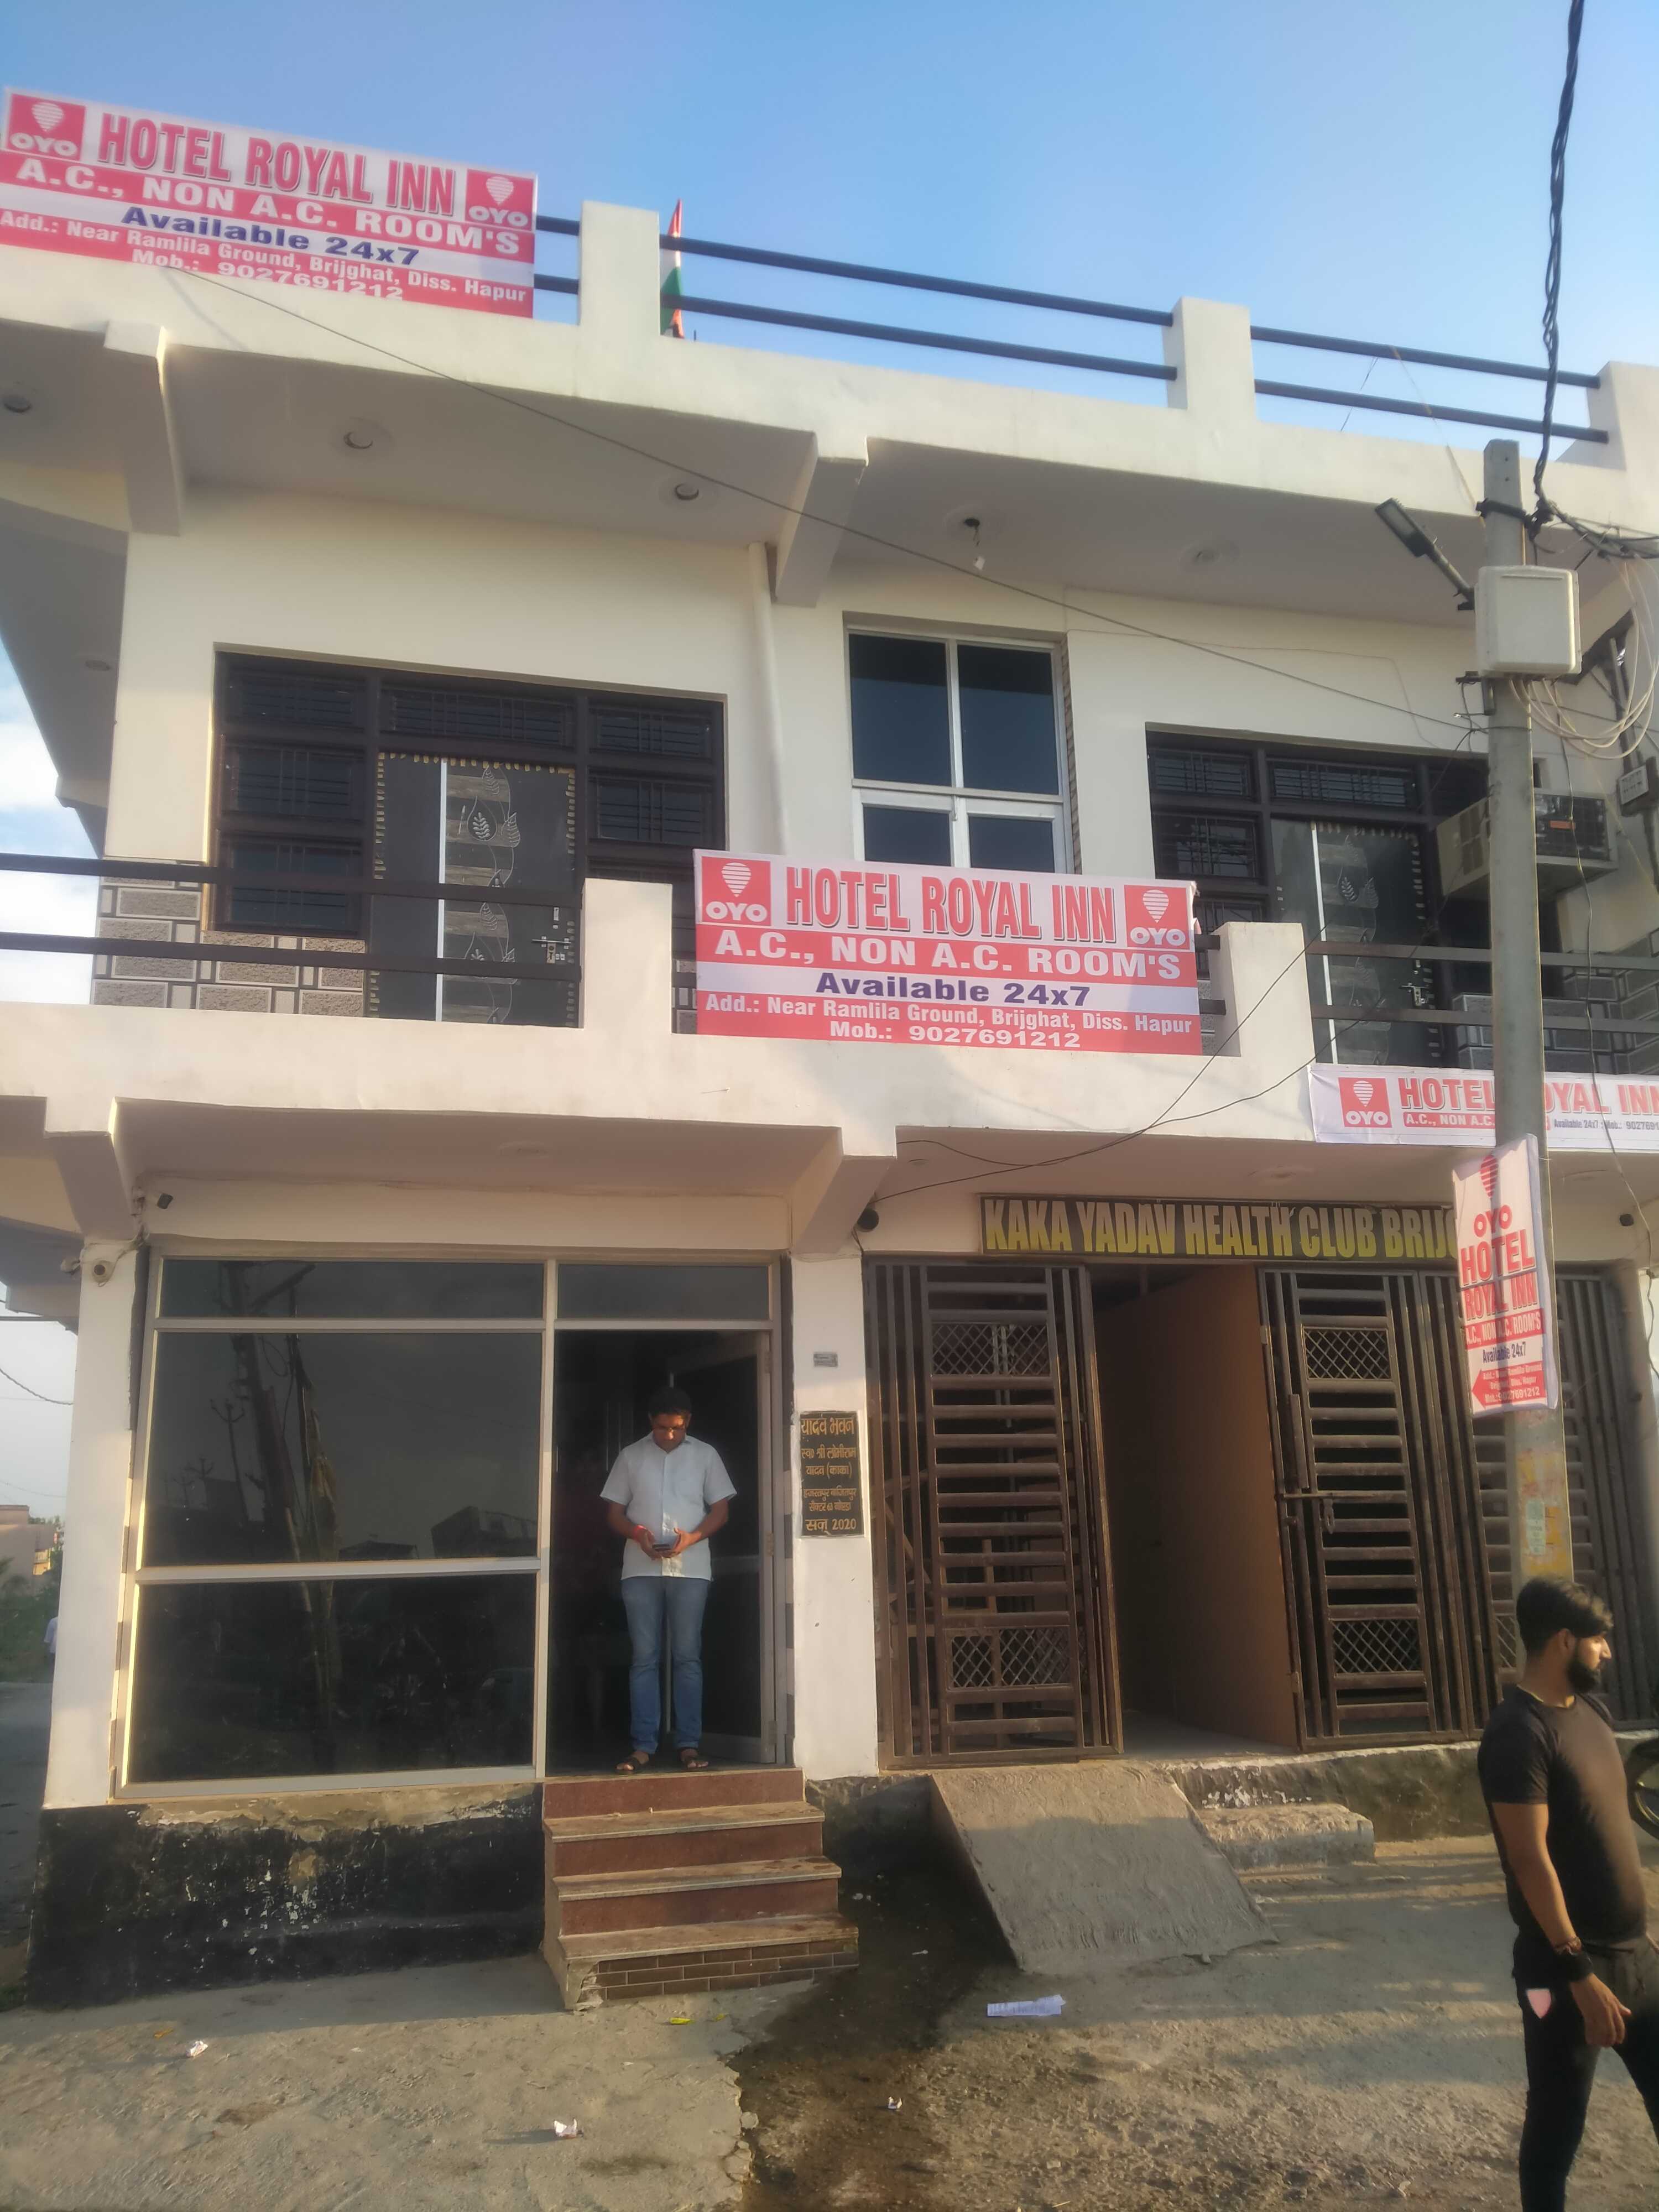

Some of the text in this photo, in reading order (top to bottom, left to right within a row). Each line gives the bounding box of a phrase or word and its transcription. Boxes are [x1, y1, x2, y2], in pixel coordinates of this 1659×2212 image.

[11, 132, 77, 156] OYO
[98, 112, 456, 216] HOTEL ROYAL INN
[16, 159, 520, 254] A.C., NON A.C. ROOM'S
[468, 204, 528, 227] OYO
[121, 207, 420, 265] Available 24x7
[66, 221, 119, 242] Near
[127, 229, 210, 256] Ramlila
[217, 243, 301, 270] Ground,
[310, 256, 399, 285] Brijghat,
[408, 270, 456, 292] Diss.
[465, 279, 526, 301] Hapur
[217, 262, 403, 300] 9027691212
[706, 901, 768, 922] OYO
[786, 867, 1117, 944] HOTEL ROYAL INN
[1130, 927, 1186, 946] OYO
[715, 930, 1181, 979] A.C., NON A.C. ROOM'S
[816, 973, 1091, 1007] Available 24x7
[706, 994, 1192, 1036] Add.: Near Ramlila Ground, Brijghat, Diss. Hapur
[830, 1020, 1081, 1048] Mob.: 9027691212
[1398, 1077, 1495, 1111] HOTEL
[1346, 1111, 1388, 1125] OYO
[1440, 1114, 1466, 1125] NON
[984, 1198, 1072, 1253] KAKA
[1076, 1201, 1176, 1254] YADAV
[1184, 1204, 1293, 1257] HEALTH
[1299, 1207, 1375, 1259] CLUB
[1474, 1204, 1512, 1238] OYO
[1460, 1229, 1536, 1286] HOTEL
[1464, 1272, 1538, 1321] ROYAL INN
[1482, 1321, 1496, 1341] NON
[1483, 1342, 1526, 1363] Available 24x7
[801, 1417, 854, 1435] यादव भवन
[832, 1518, 856, 1530] 2020
